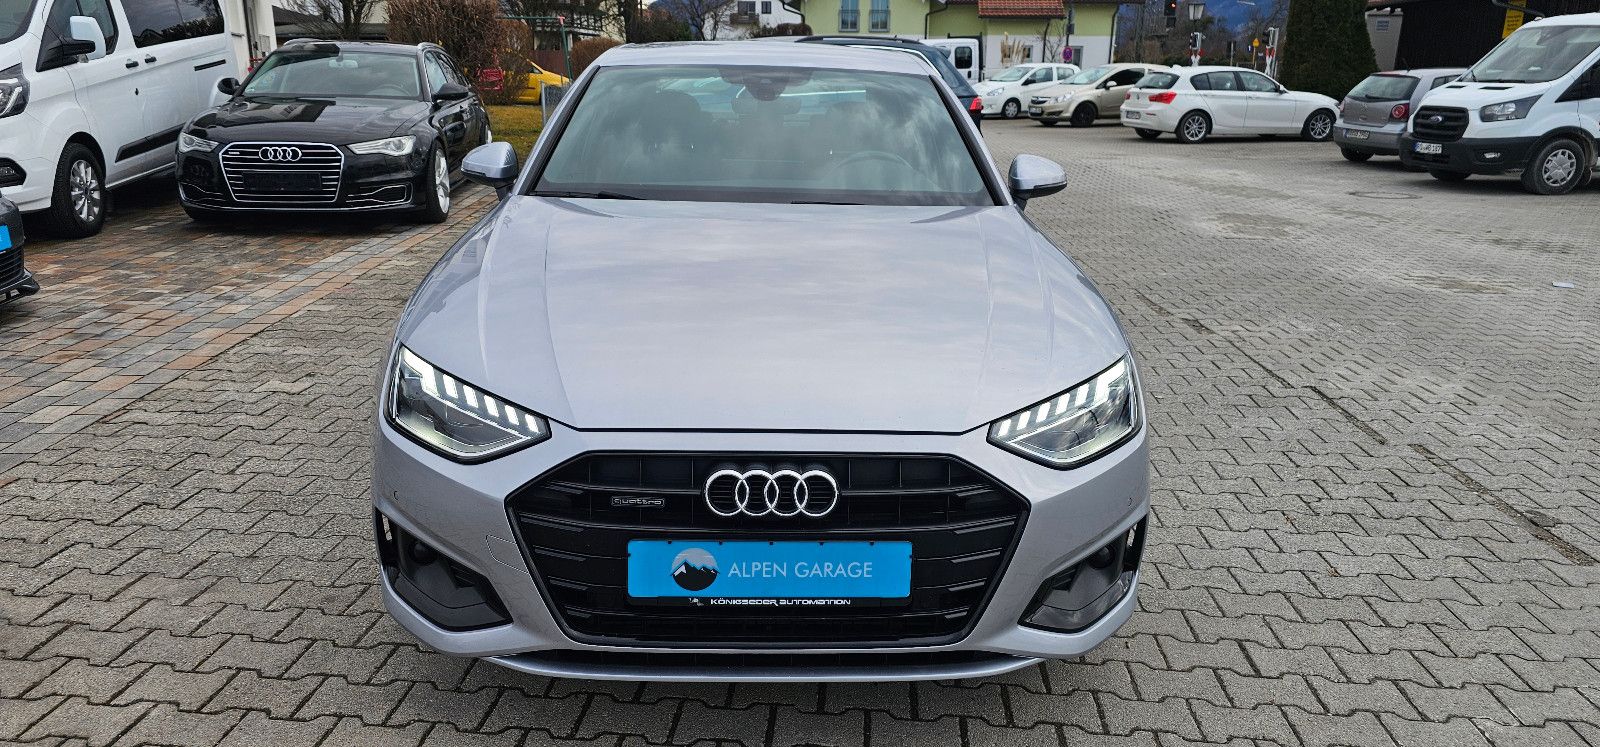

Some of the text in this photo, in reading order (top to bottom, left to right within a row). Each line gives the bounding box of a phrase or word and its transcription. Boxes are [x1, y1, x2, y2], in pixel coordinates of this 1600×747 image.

[613, 497, 662, 506] quattro
[728, 562, 873, 578] ALPEN GARAGE
[710, 597, 778, 606] KÖNIGSEDER
